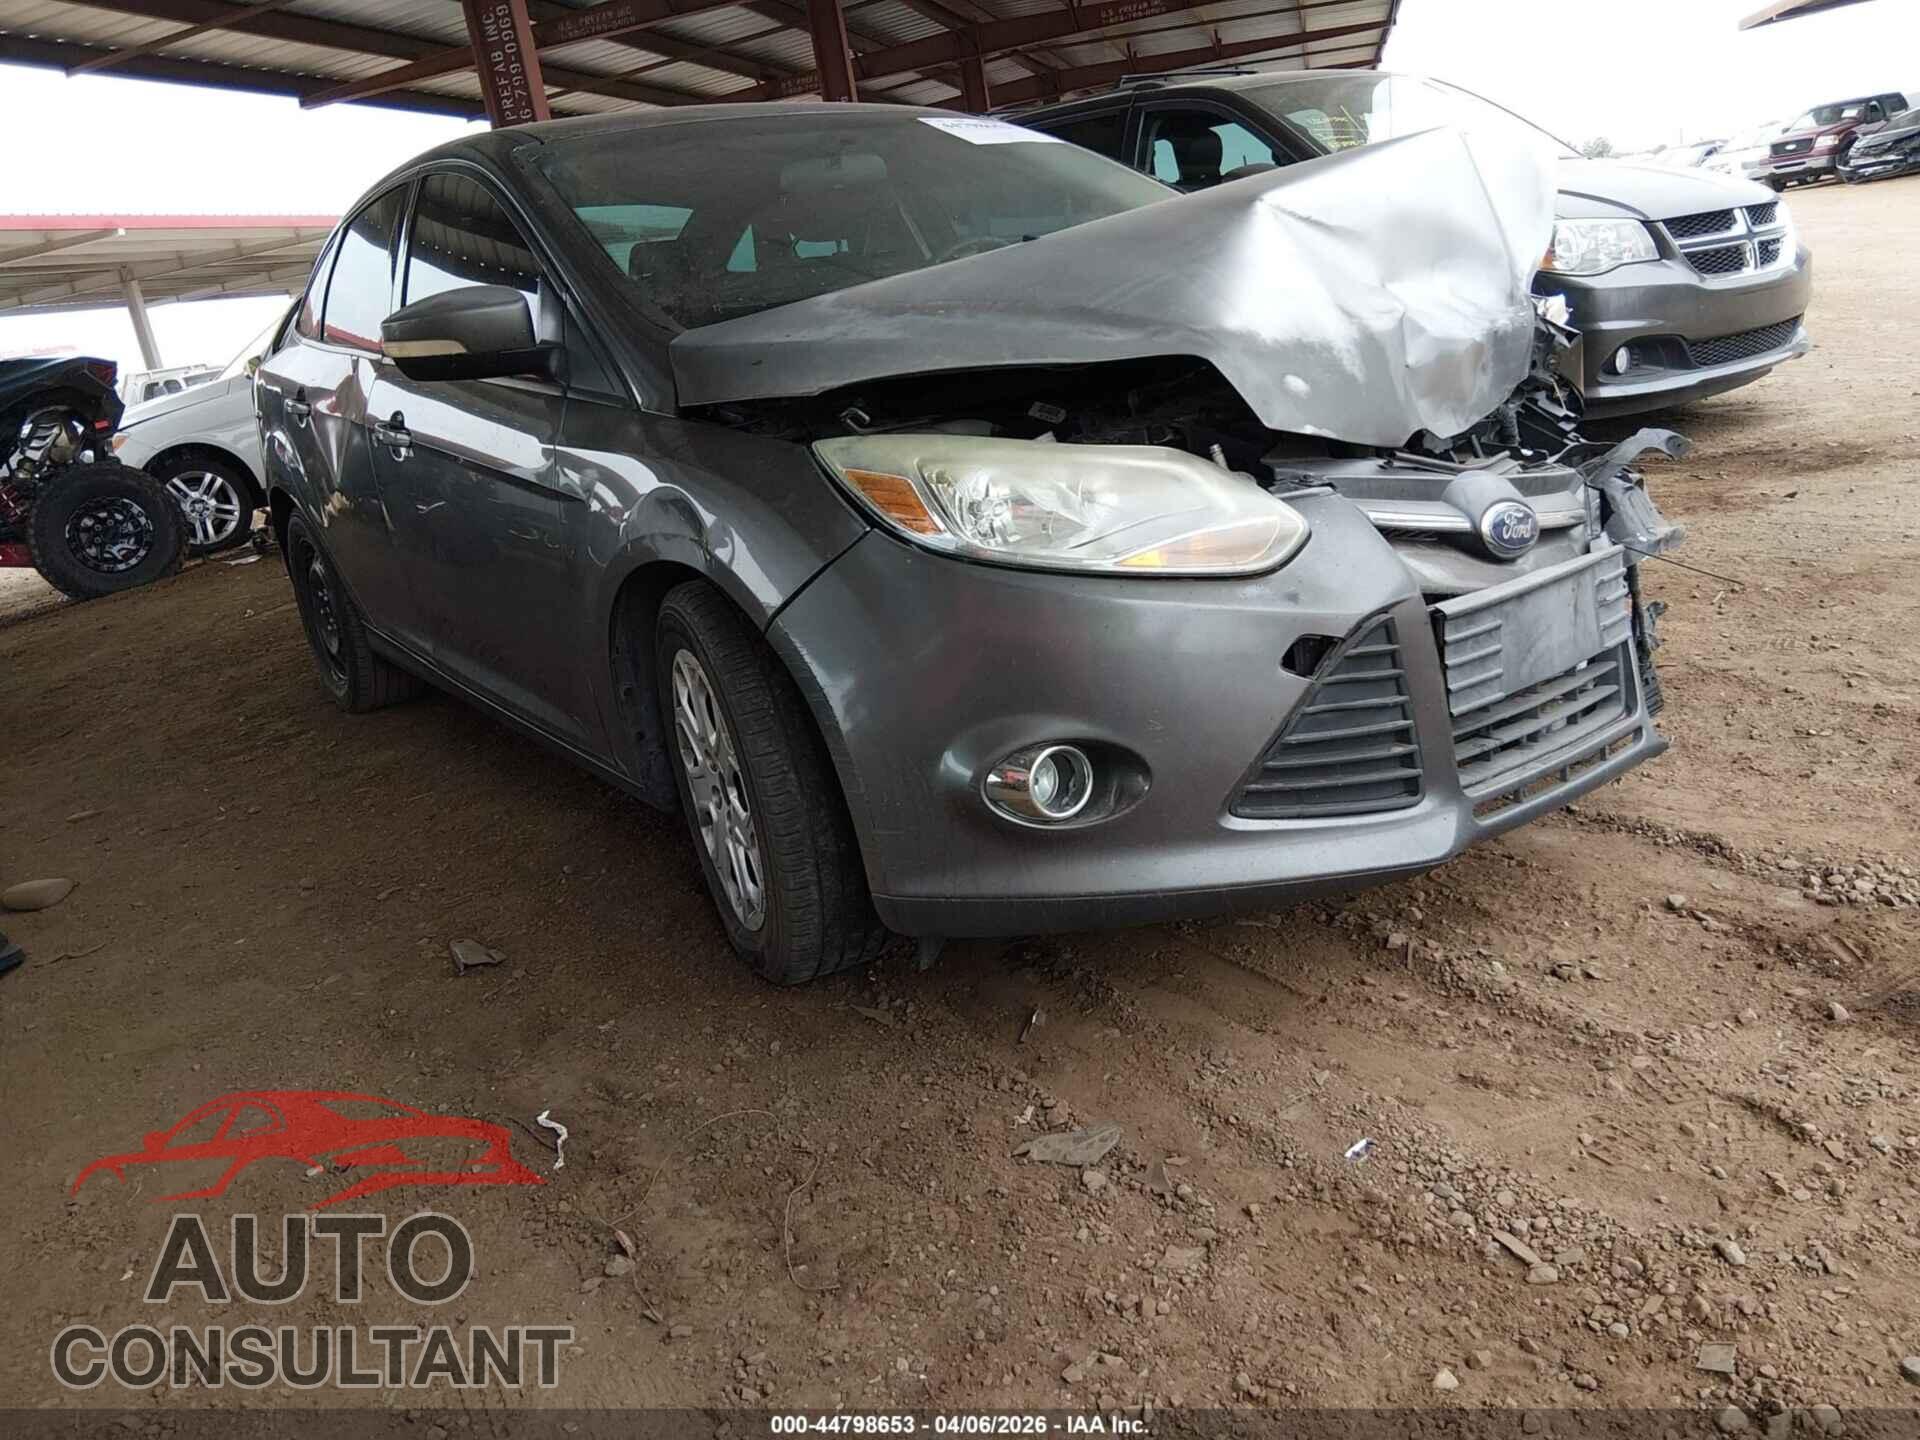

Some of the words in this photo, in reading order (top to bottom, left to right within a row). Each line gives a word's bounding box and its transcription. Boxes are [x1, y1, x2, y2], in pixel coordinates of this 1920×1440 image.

[482, 7, 499, 41] INC.
[490, 51, 517, 120] PREFAB
[1502, 511, 1531, 539] Ford
